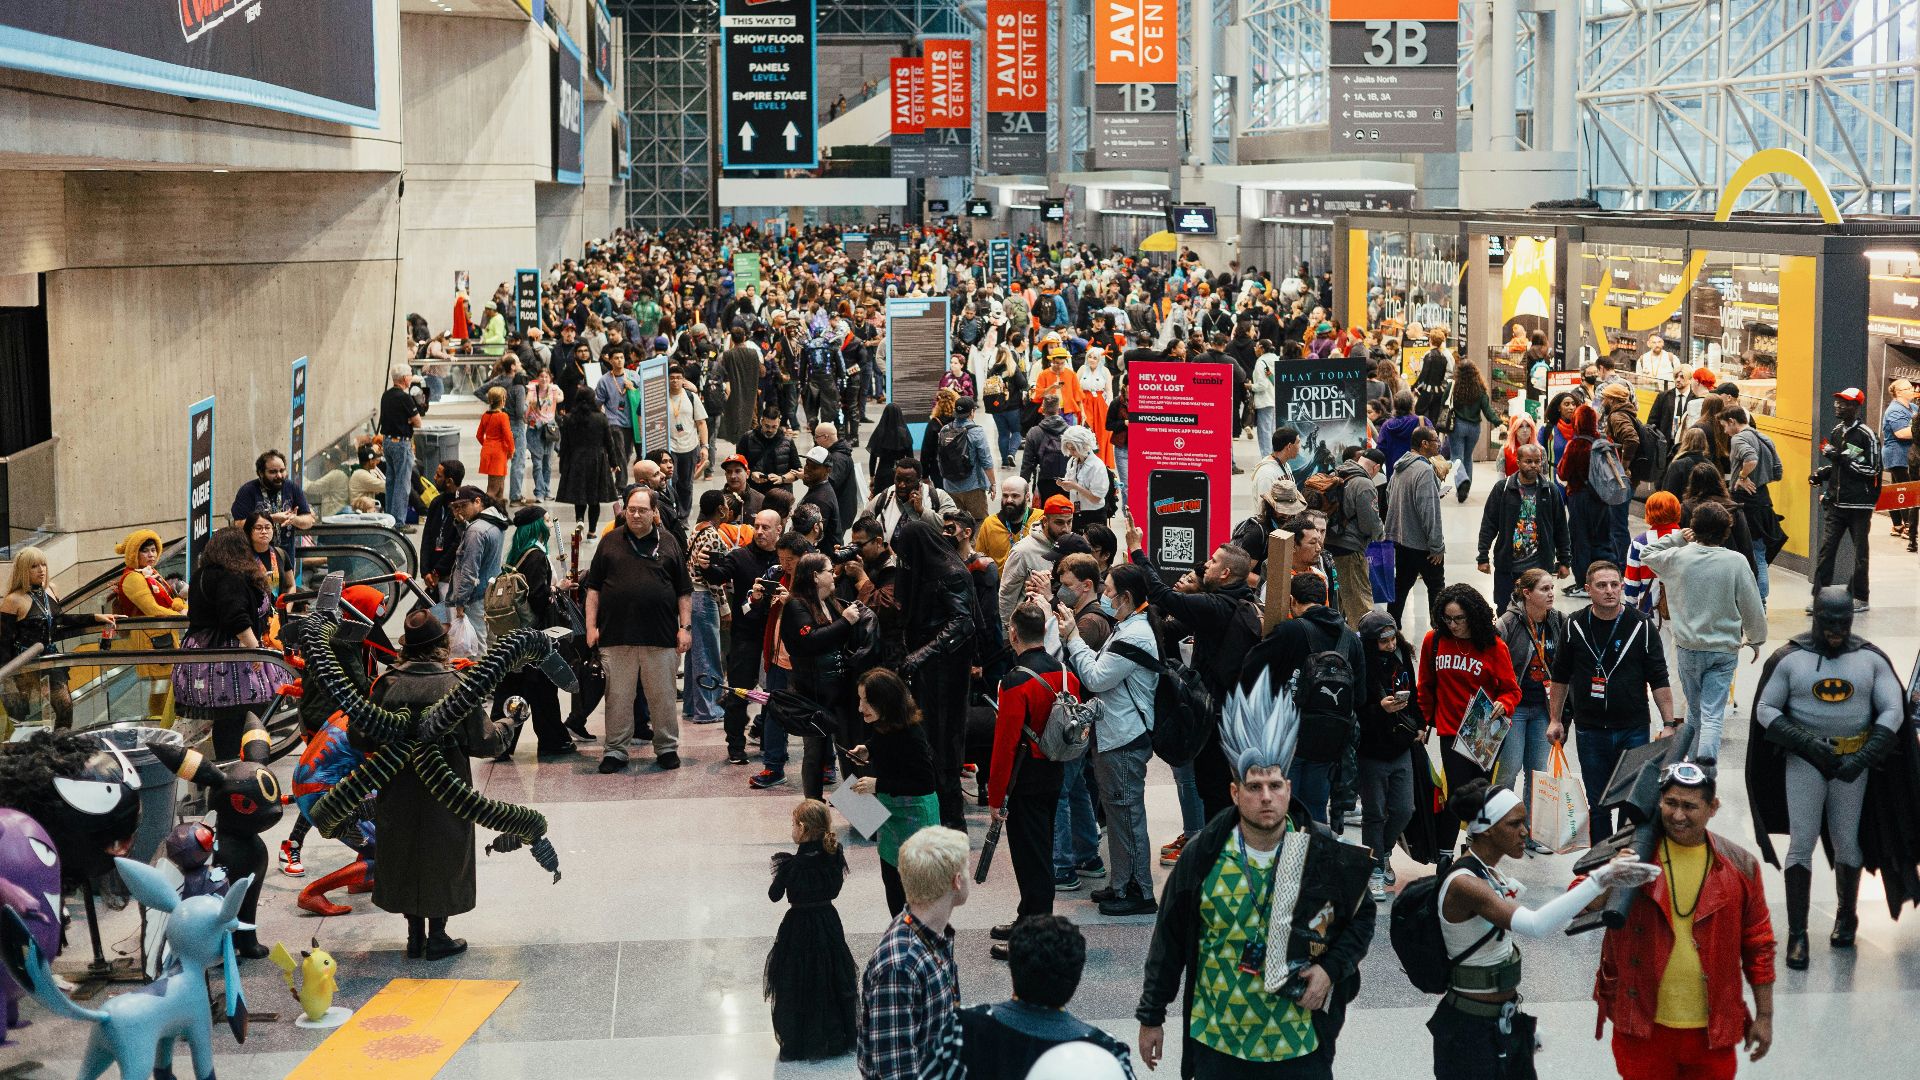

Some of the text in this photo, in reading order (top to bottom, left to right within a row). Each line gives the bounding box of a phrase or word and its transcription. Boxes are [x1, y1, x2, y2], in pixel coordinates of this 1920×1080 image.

[732, 17, 753, 25] THIS
[755, 17, 776, 25] WAY
[733, 34, 804, 44] SHOW FLOOR
[752, 45, 778, 53] LEVEL
[1363, 20, 1428, 65] 3B
[996, 13, 1016, 97] JAVITS
[1022, 13, 1038, 98] CENTER
[749, 63, 790, 72] PANELS
[752, 74, 786, 82] LEVEL 4
[931, 50, 948, 117] JAVITS
[952, 50, 964, 117] CENTER
[1353, 75, 1398, 83] Javits North
[732, 91, 807, 101] EMPIRE STAGE
[753, 102, 778, 110] LEVEL
[896, 67, 910, 124] JAVITS
[914, 67, 926, 124] CENTER
[1118, 83, 1156, 112] 1B
[1353, 93, 1392, 102] 1A, 1B, 3A
[1001, 112, 1033, 133] 3A
[1353, 110, 1418, 119] Elevator to 1C, 3B
[936, 128, 960, 144] 1A
[1374, 245, 1420, 289] Shopping
[1722, 278, 1743, 302] Just
[520, 300, 536, 308] SHOW
[1385, 288, 1452, 329] the checkout
[520, 310, 538, 320] FLOOR
[1719, 306, 1744, 330] Walk
[1722, 332, 1742, 356] Out
[1138, 373, 1177, 382] HEY, YOU
[1192, 376, 1223, 385] tumblr
[1281, 370, 1360, 382] PLAY TODAY
[1138, 384, 1184, 392] LOOK LOST
[1293, 385, 1338, 402] LORDS
[1286, 399, 1356, 422] FALLEN
[192, 456, 210, 478] DOWN TO
[192, 480, 210, 510] QUEUE
[1157, 502, 1182, 514] COMIC
[1183, 500, 1200, 511] CON
[194, 514, 208, 540] HALL
[1452, 654, 1483, 676] DAYS
[1566, 792, 1575, 818] wholly
